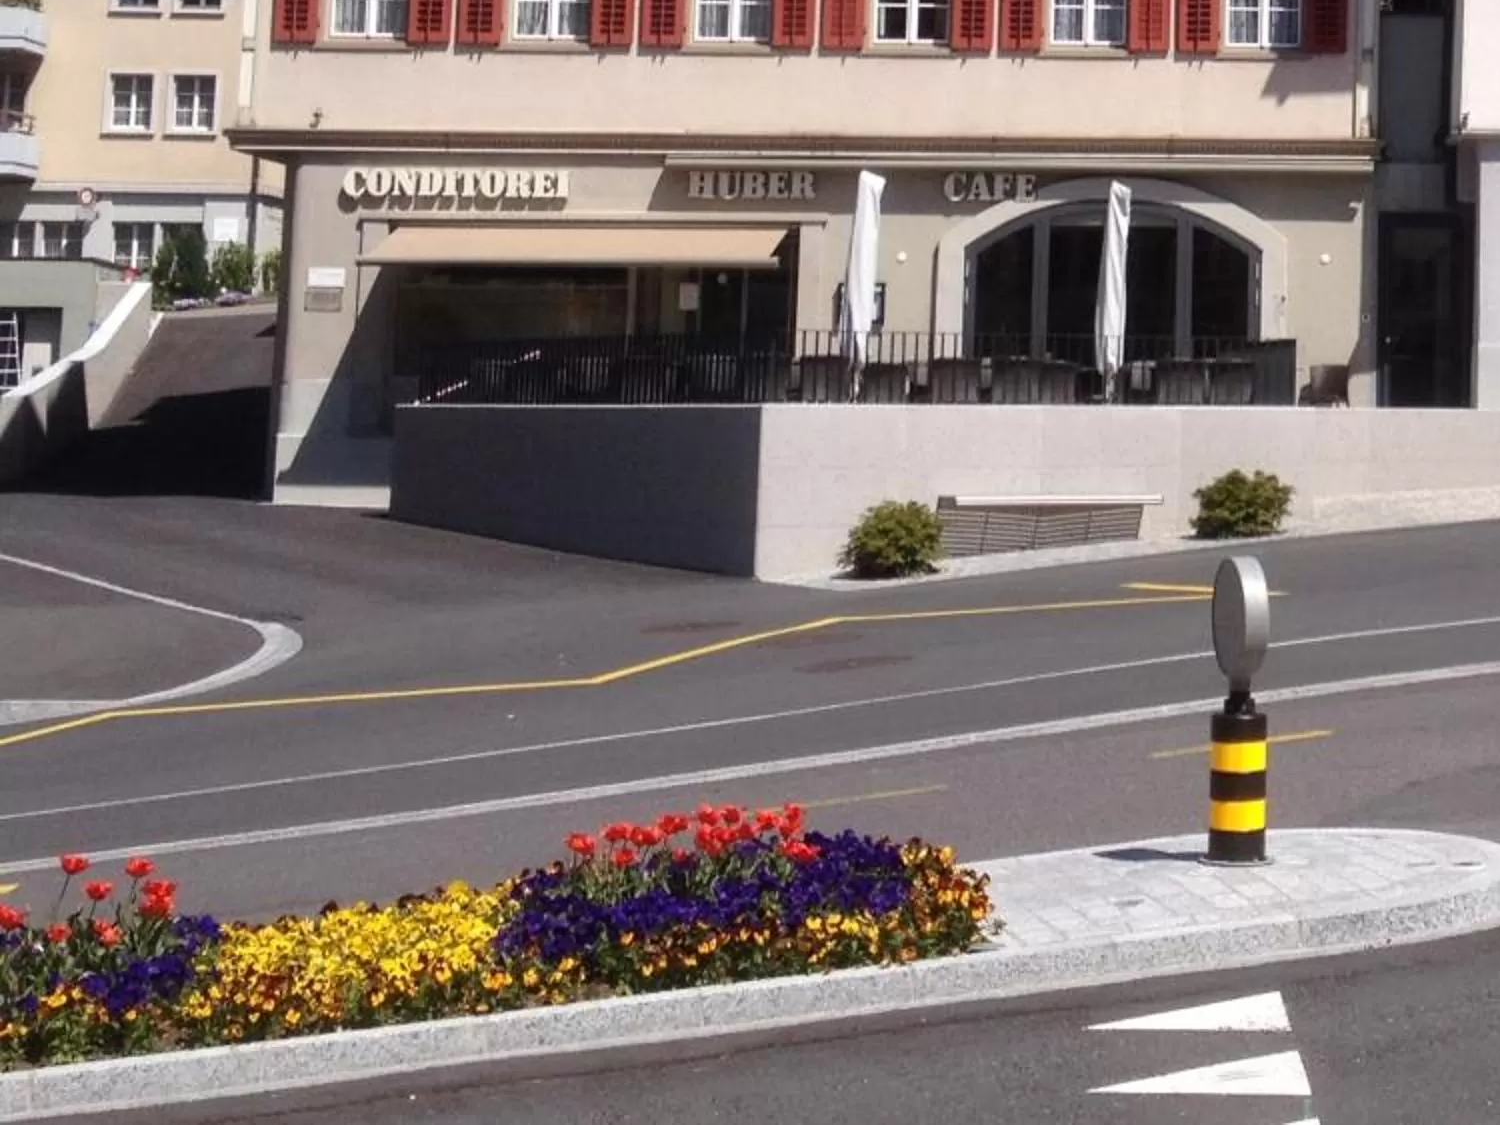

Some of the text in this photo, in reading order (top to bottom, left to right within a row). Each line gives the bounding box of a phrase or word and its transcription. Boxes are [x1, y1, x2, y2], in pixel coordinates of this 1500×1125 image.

[342, 165, 1038, 203] CONDITOREI HUBER CAFE
